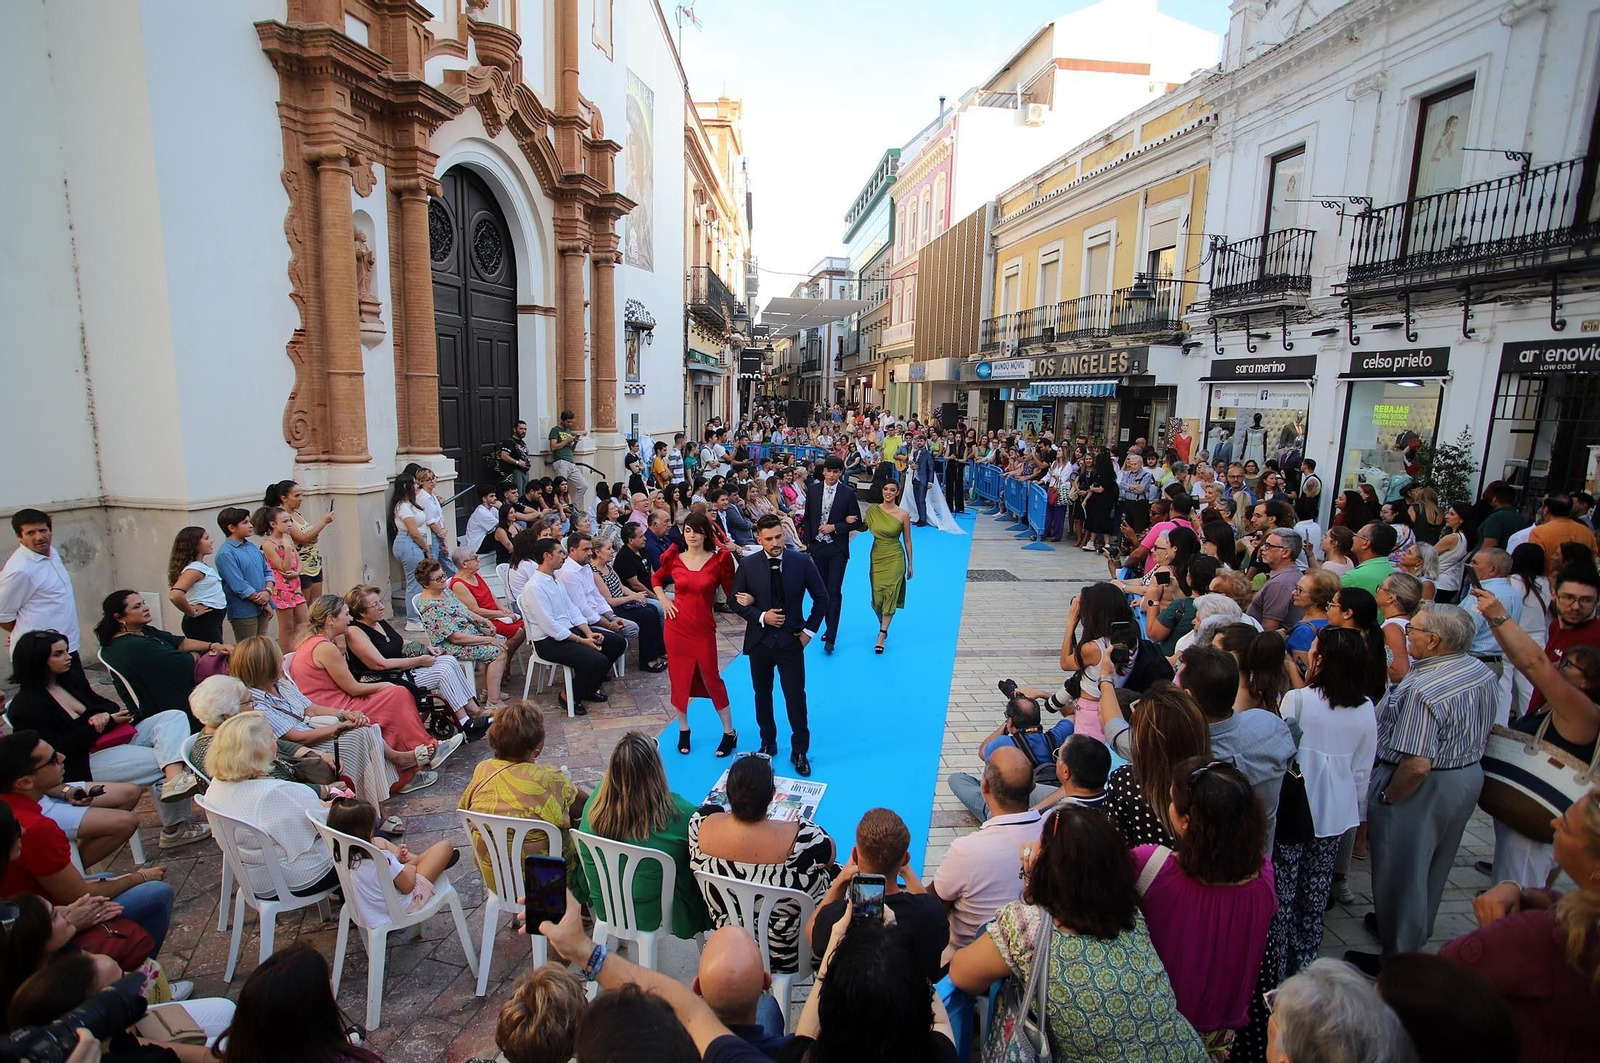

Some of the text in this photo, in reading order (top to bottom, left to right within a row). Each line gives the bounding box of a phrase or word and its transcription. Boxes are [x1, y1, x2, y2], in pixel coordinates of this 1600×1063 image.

[1363, 350, 1432, 372] celso prieto
[1518, 343, 1600, 363] arenovi
[1033, 352, 1130, 377] LOS ANGELES
[1235, 361, 1286, 374] sara merino
[1048, 385, 1093, 395] LOS ANGELES
[1374, 405, 1409, 413] REBAJAS
